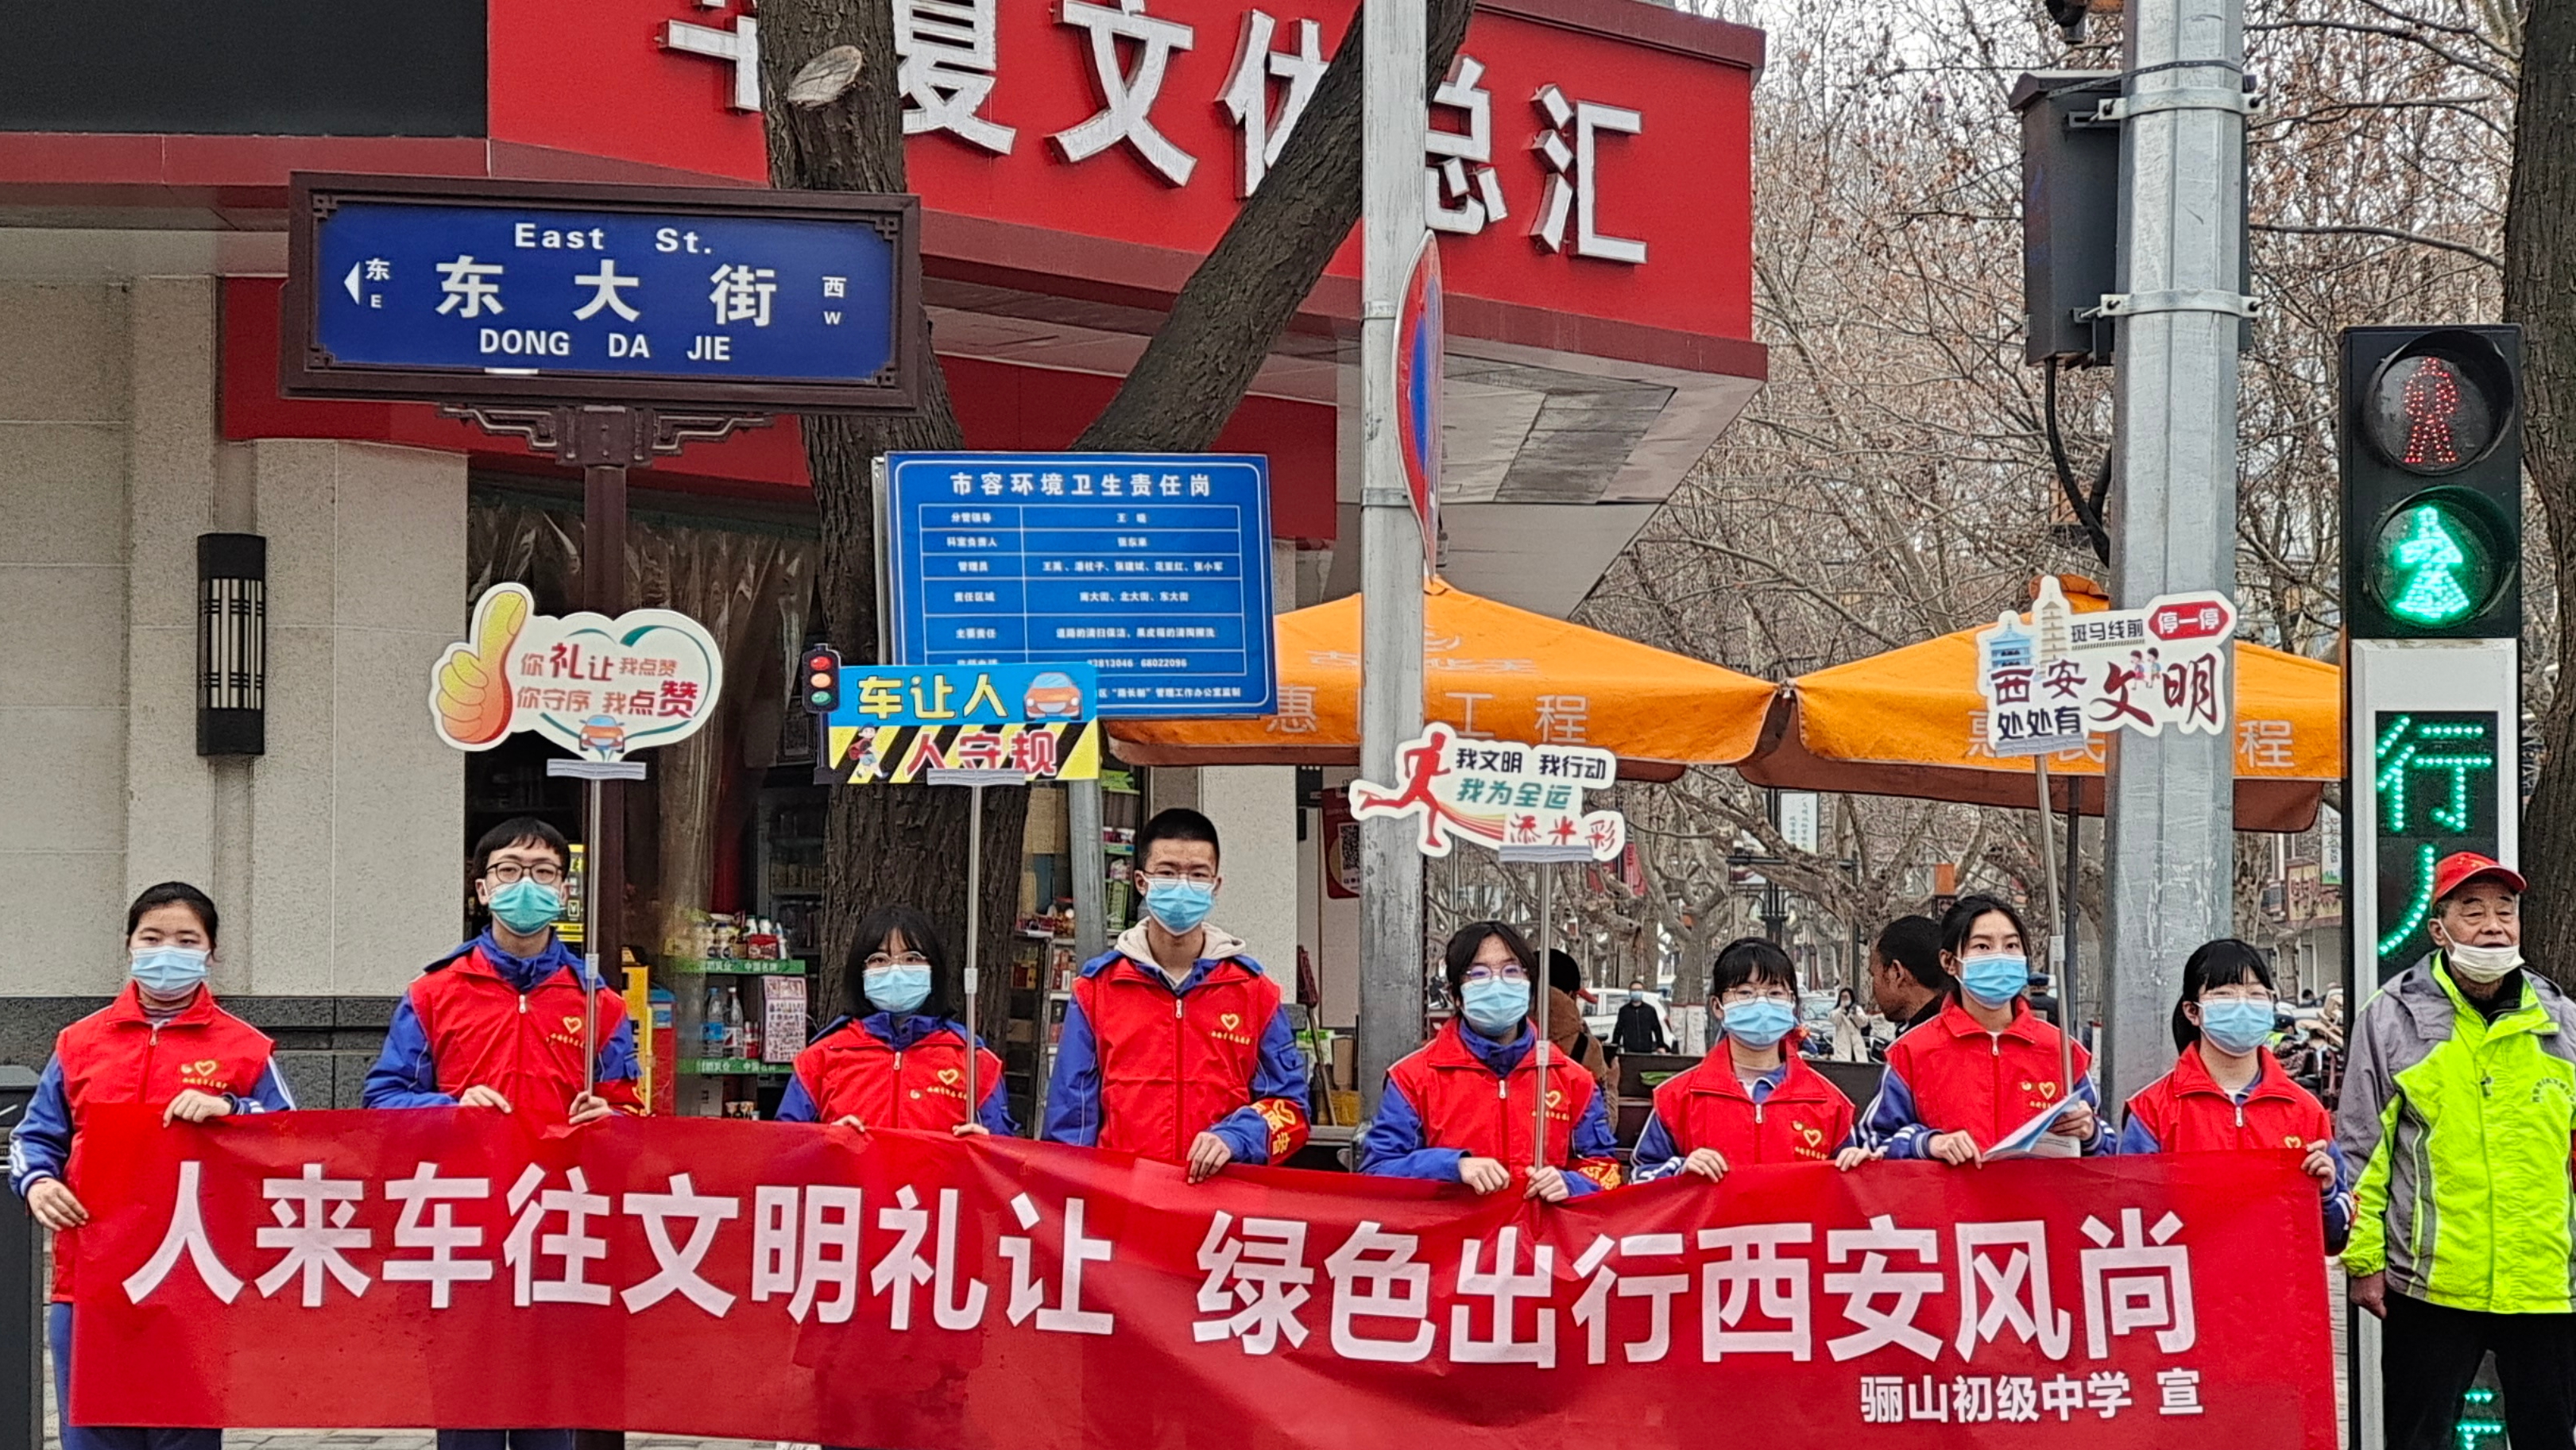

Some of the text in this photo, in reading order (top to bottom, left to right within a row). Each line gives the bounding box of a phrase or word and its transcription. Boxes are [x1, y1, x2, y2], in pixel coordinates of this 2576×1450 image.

[514, 222, 712, 253] East St.
[365, 258, 390, 281] 东
[370, 294, 381, 308] E
[435, 254, 777, 327] 东大街
[822, 276, 846, 298] 西
[824, 311, 841, 325] W
[480, 328, 730, 362] DONG DA JIE
[950, 472, 1211, 497] 市容环境卫生责任岗
[951, 512, 992, 524] 分管领导
[946, 536, 998, 548] 科室负责人
[957, 561, 989, 573] 管理员
[953, 591, 996, 603] 责任区域
[1079, 591, 1189, 603] 南大街、北大街、东大街
[956, 628, 997, 640] 主要责任
[2070, 619, 2145, 644] 斑马线前
[2157, 607, 2220, 636] 停一停
[520, 642, 678, 682] 你礼让 我点赞
[857, 672, 1010, 721] 车让人
[1989, 659, 2088, 706] 西安
[2087, 652, 2218, 728] 文明
[516, 680, 699, 720] 你守序 我点赞
[1265, 683, 1589, 744] 惠工程
[1996, 706, 2082, 741] 处处有
[904, 729, 1058, 776] 人守规
[1456, 747, 1607, 780] 我文明 我行动
[1456, 778, 1572, 810] 我为全运
[121, 1160, 2199, 1370] 人来车往文明礼让 绿色出行西安风尚
[1859, 1367, 2204, 1425] 骊山初级中学 宣
